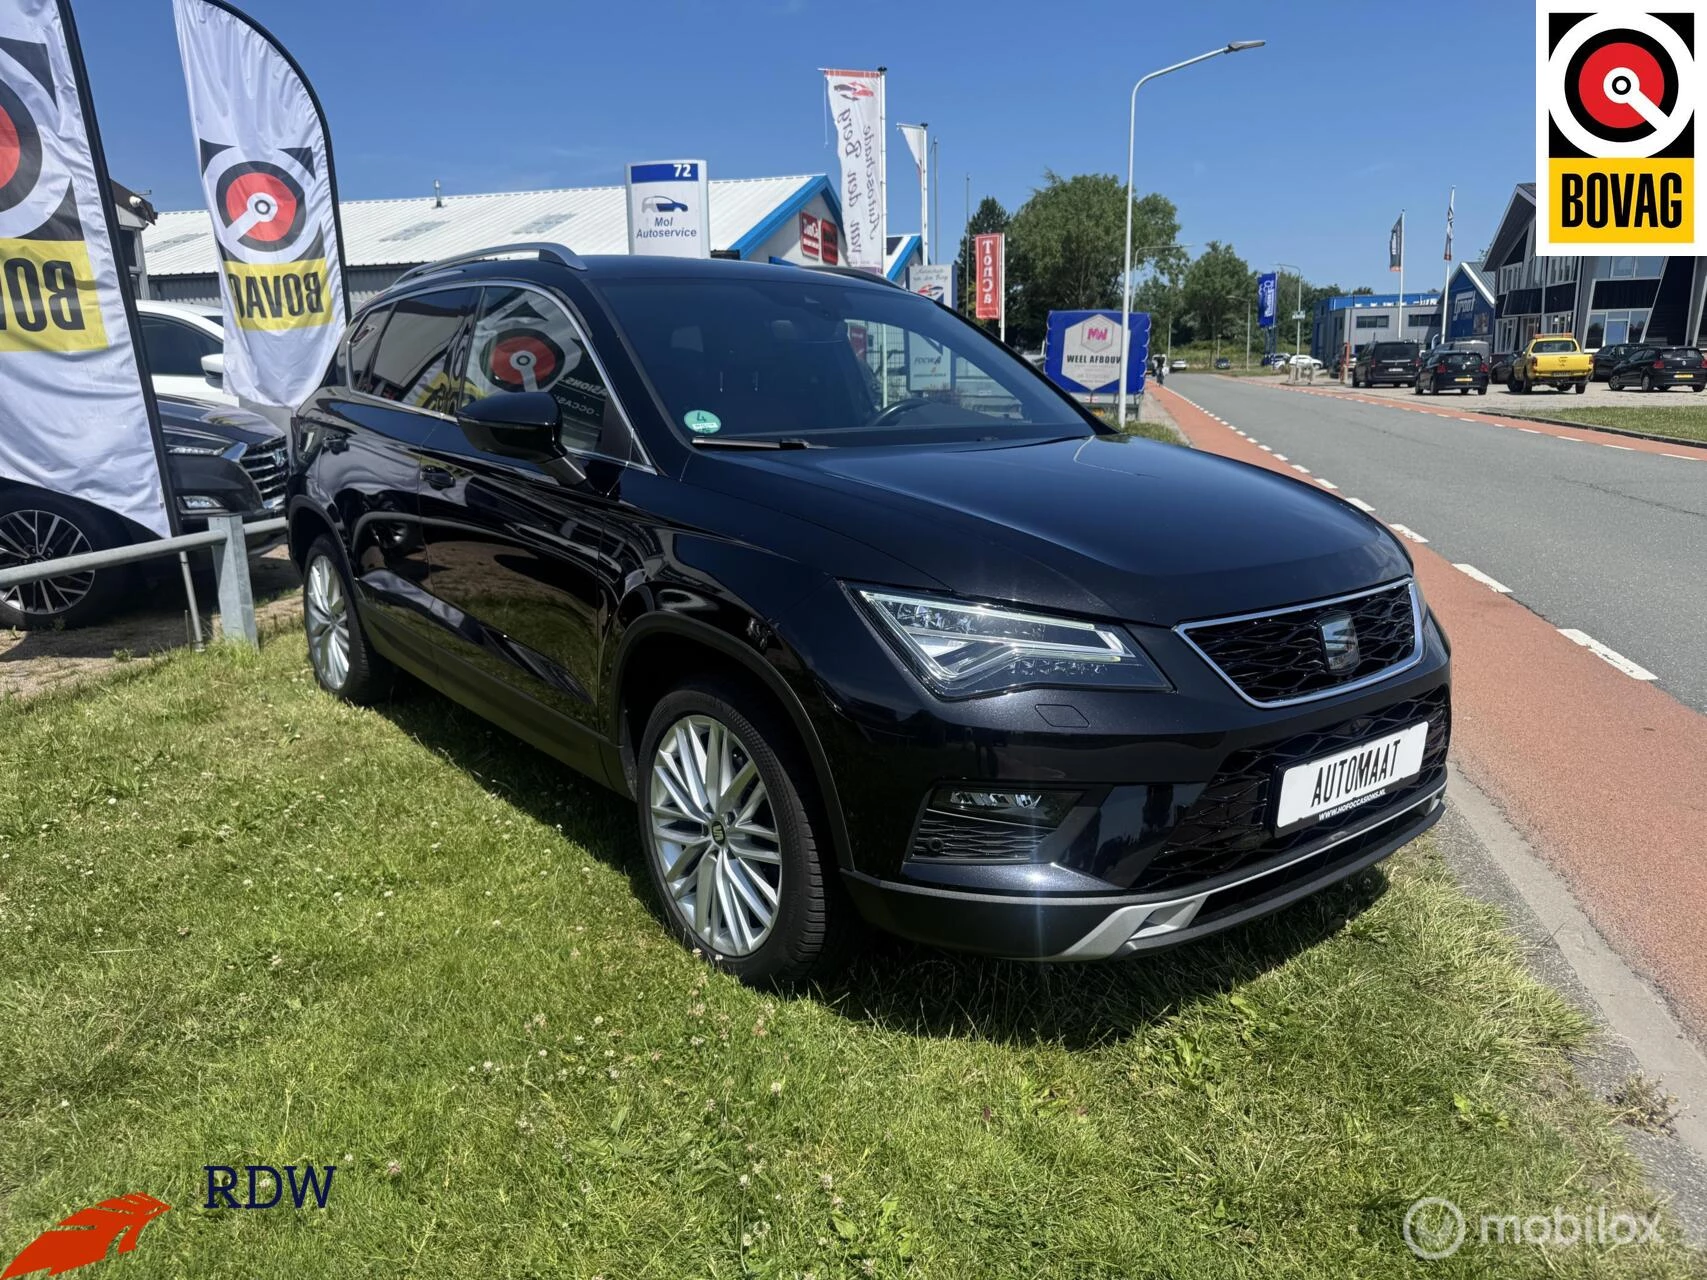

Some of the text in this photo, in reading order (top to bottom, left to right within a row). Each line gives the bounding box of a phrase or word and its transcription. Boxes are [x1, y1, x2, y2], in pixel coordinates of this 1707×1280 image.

[673, 164, 692, 178] 72
[654, 217, 674, 227] Mol
[636, 228, 697, 239] Autoservice
[1066, 354, 1087, 364] WEEL
[1310, 738, 1401, 808] AUTOMAAT
